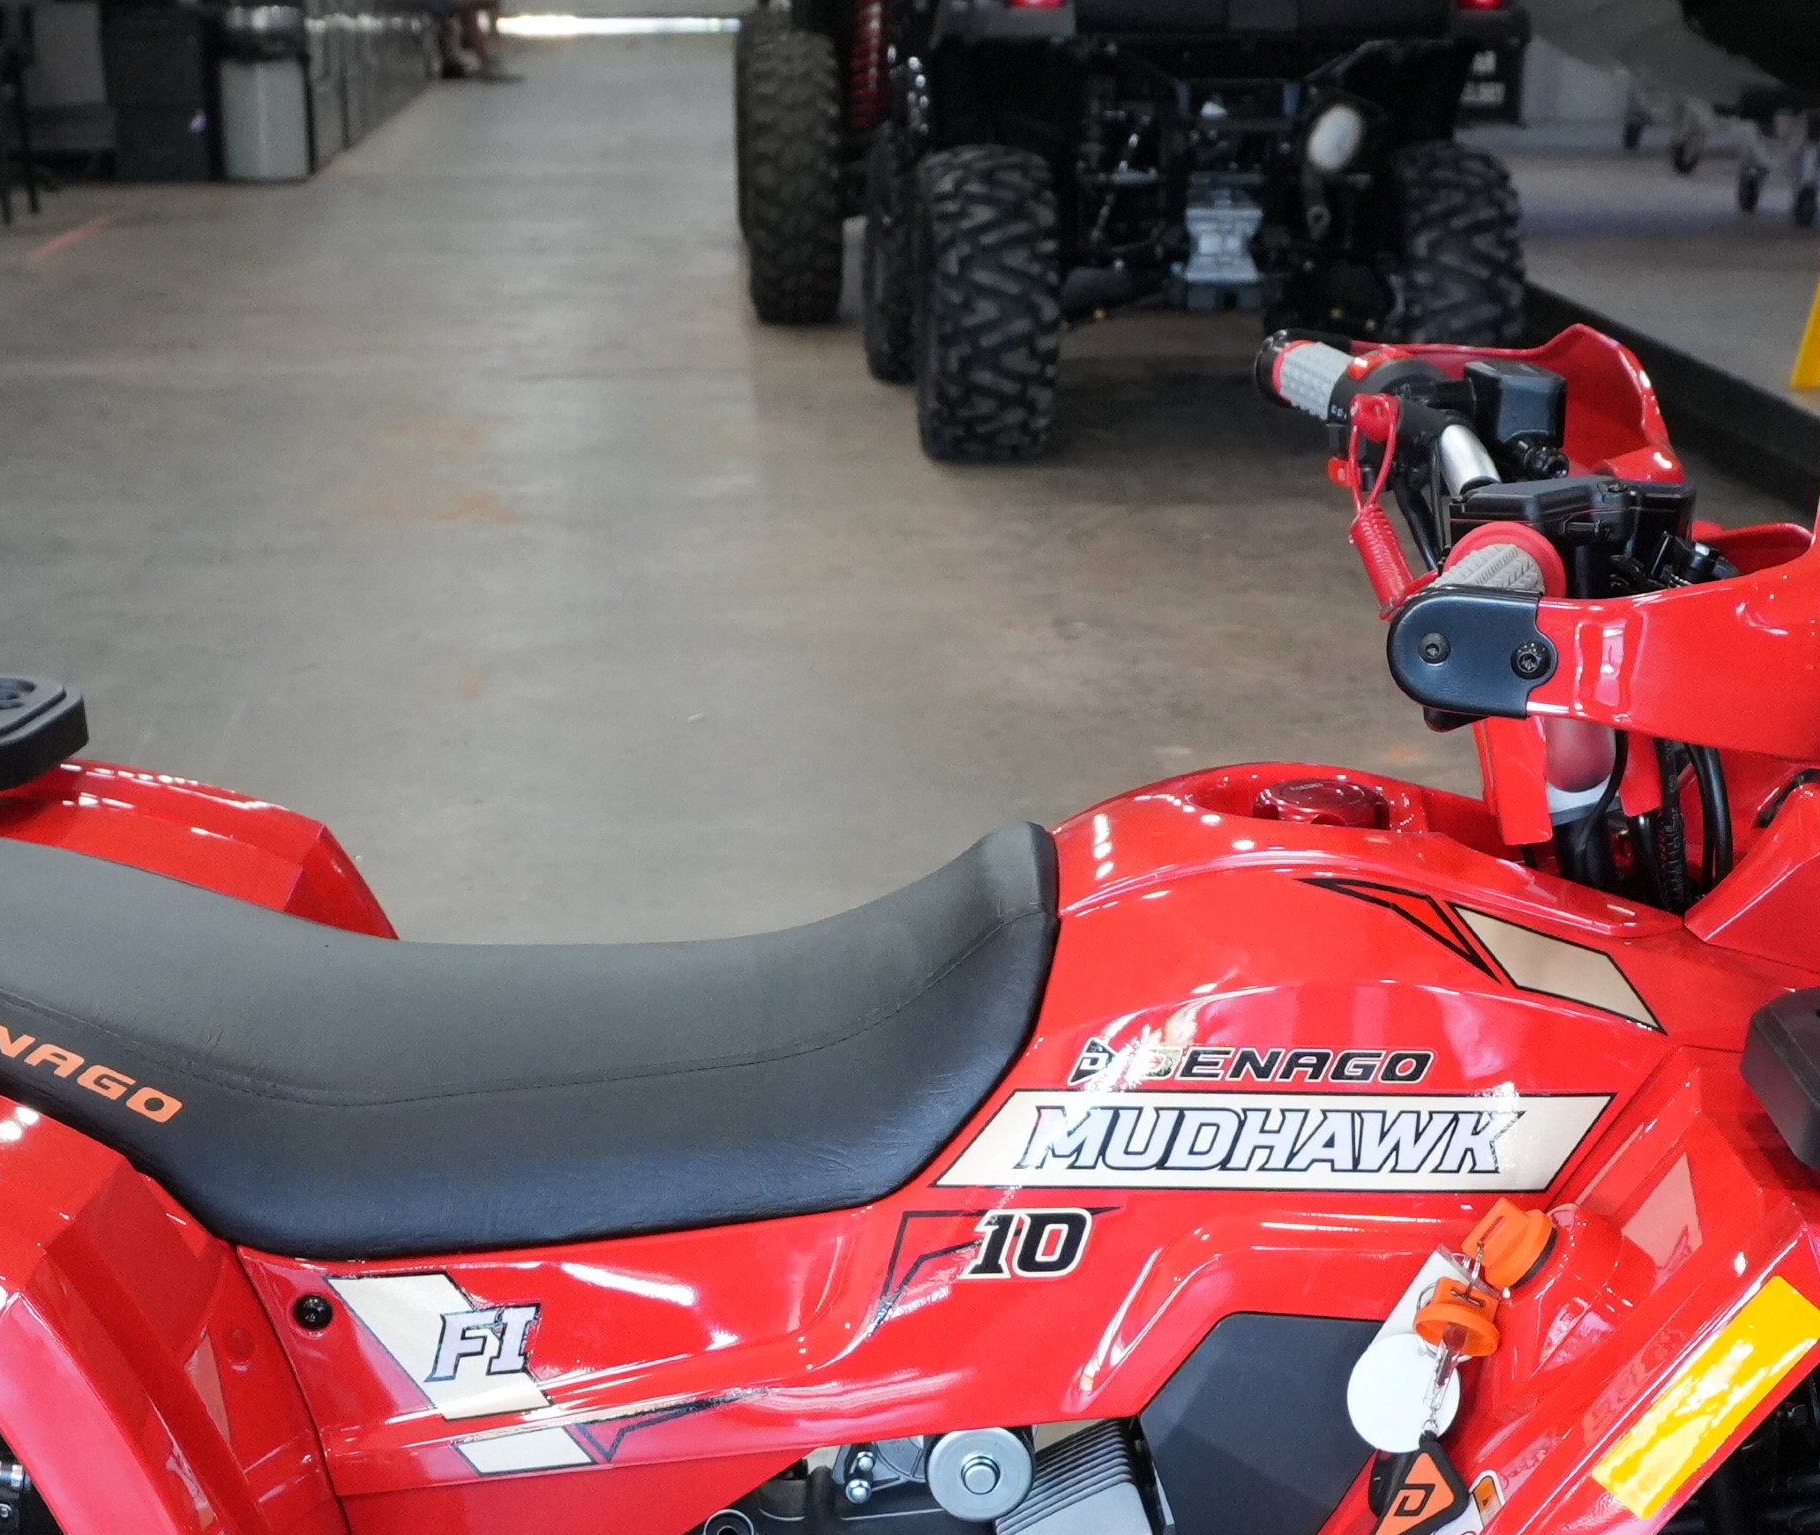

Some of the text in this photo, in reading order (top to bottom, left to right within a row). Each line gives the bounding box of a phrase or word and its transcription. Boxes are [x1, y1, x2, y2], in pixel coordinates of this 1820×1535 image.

[1145, 1046, 1434, 1085] DENAGO
[1011, 1104, 1527, 1175] MUDHAWK
[962, 1207, 1093, 1280] 10
